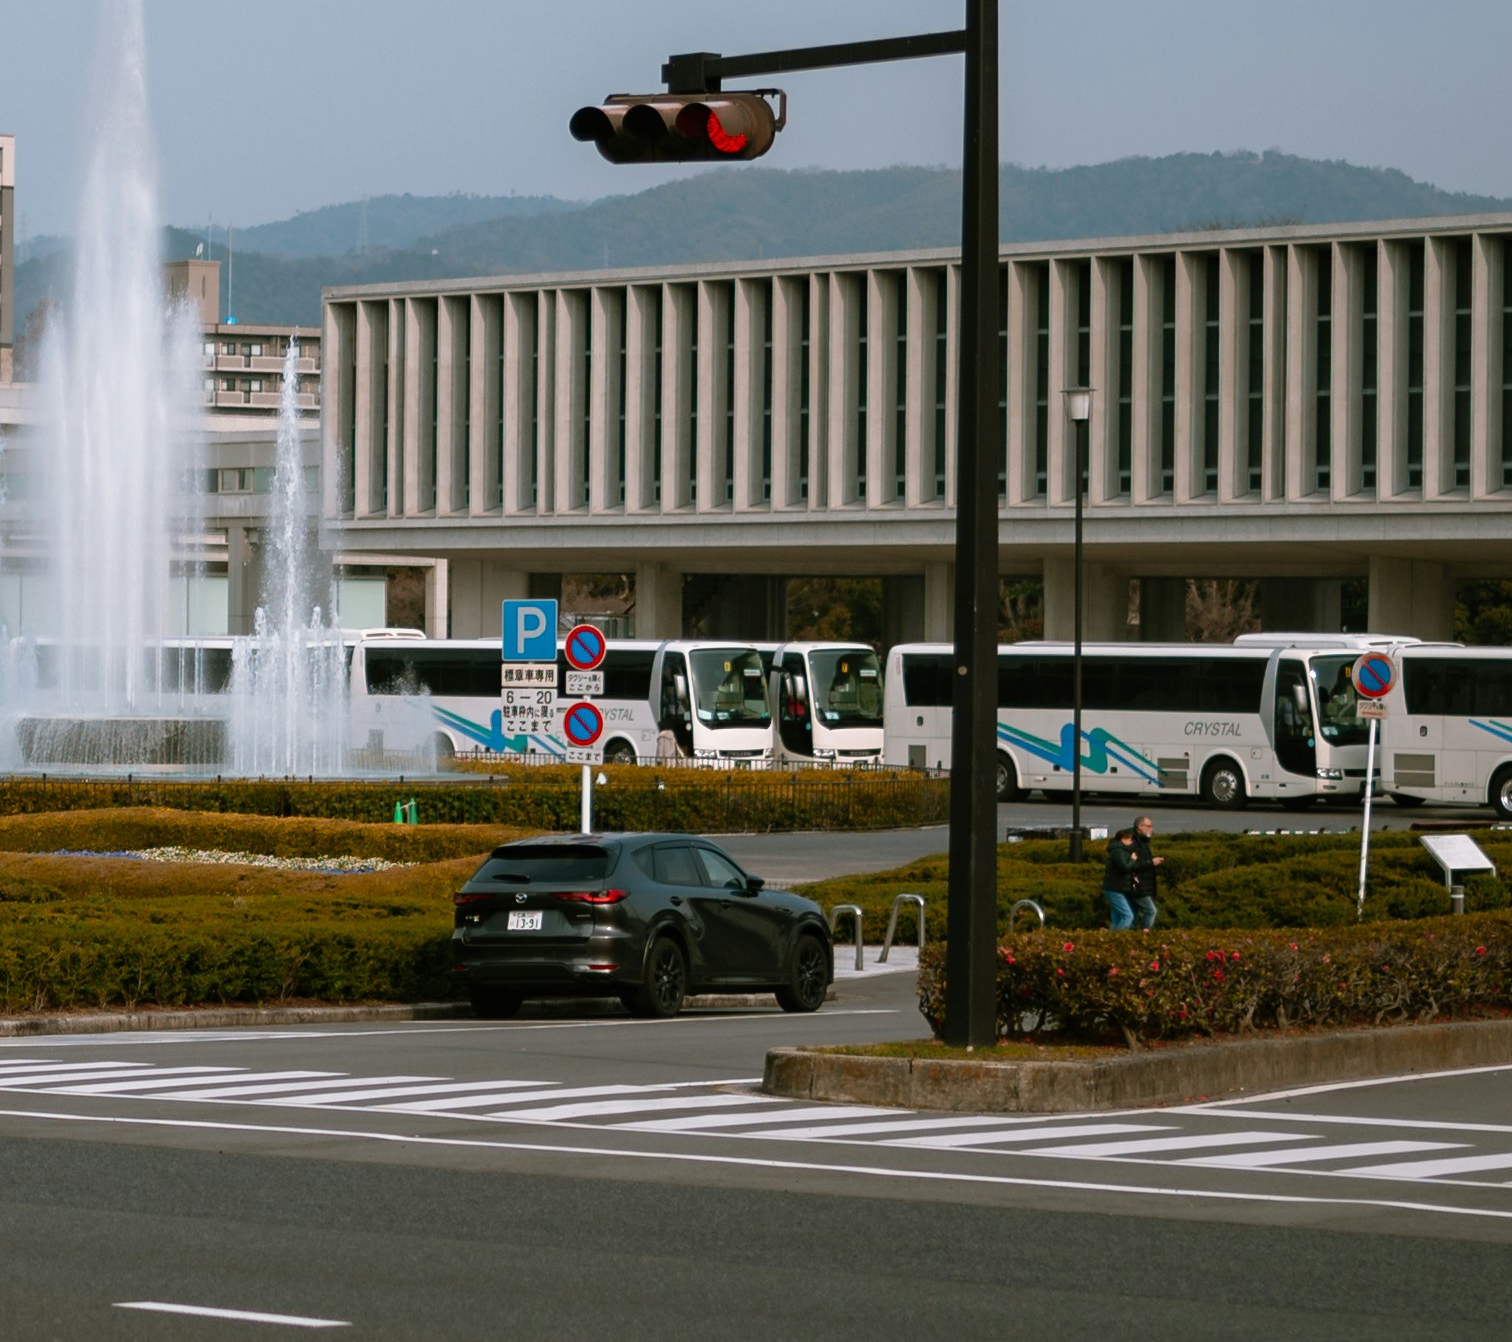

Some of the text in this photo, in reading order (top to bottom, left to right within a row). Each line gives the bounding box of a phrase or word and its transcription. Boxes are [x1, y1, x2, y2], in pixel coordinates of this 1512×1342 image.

[517, 606, 547, 654] P
[569, 683, 599, 691] ここから
[507, 721, 551, 733] ここまで
[1184, 722, 1242, 736] CRYSTAL
[569, 752, 600, 761] ここまで
